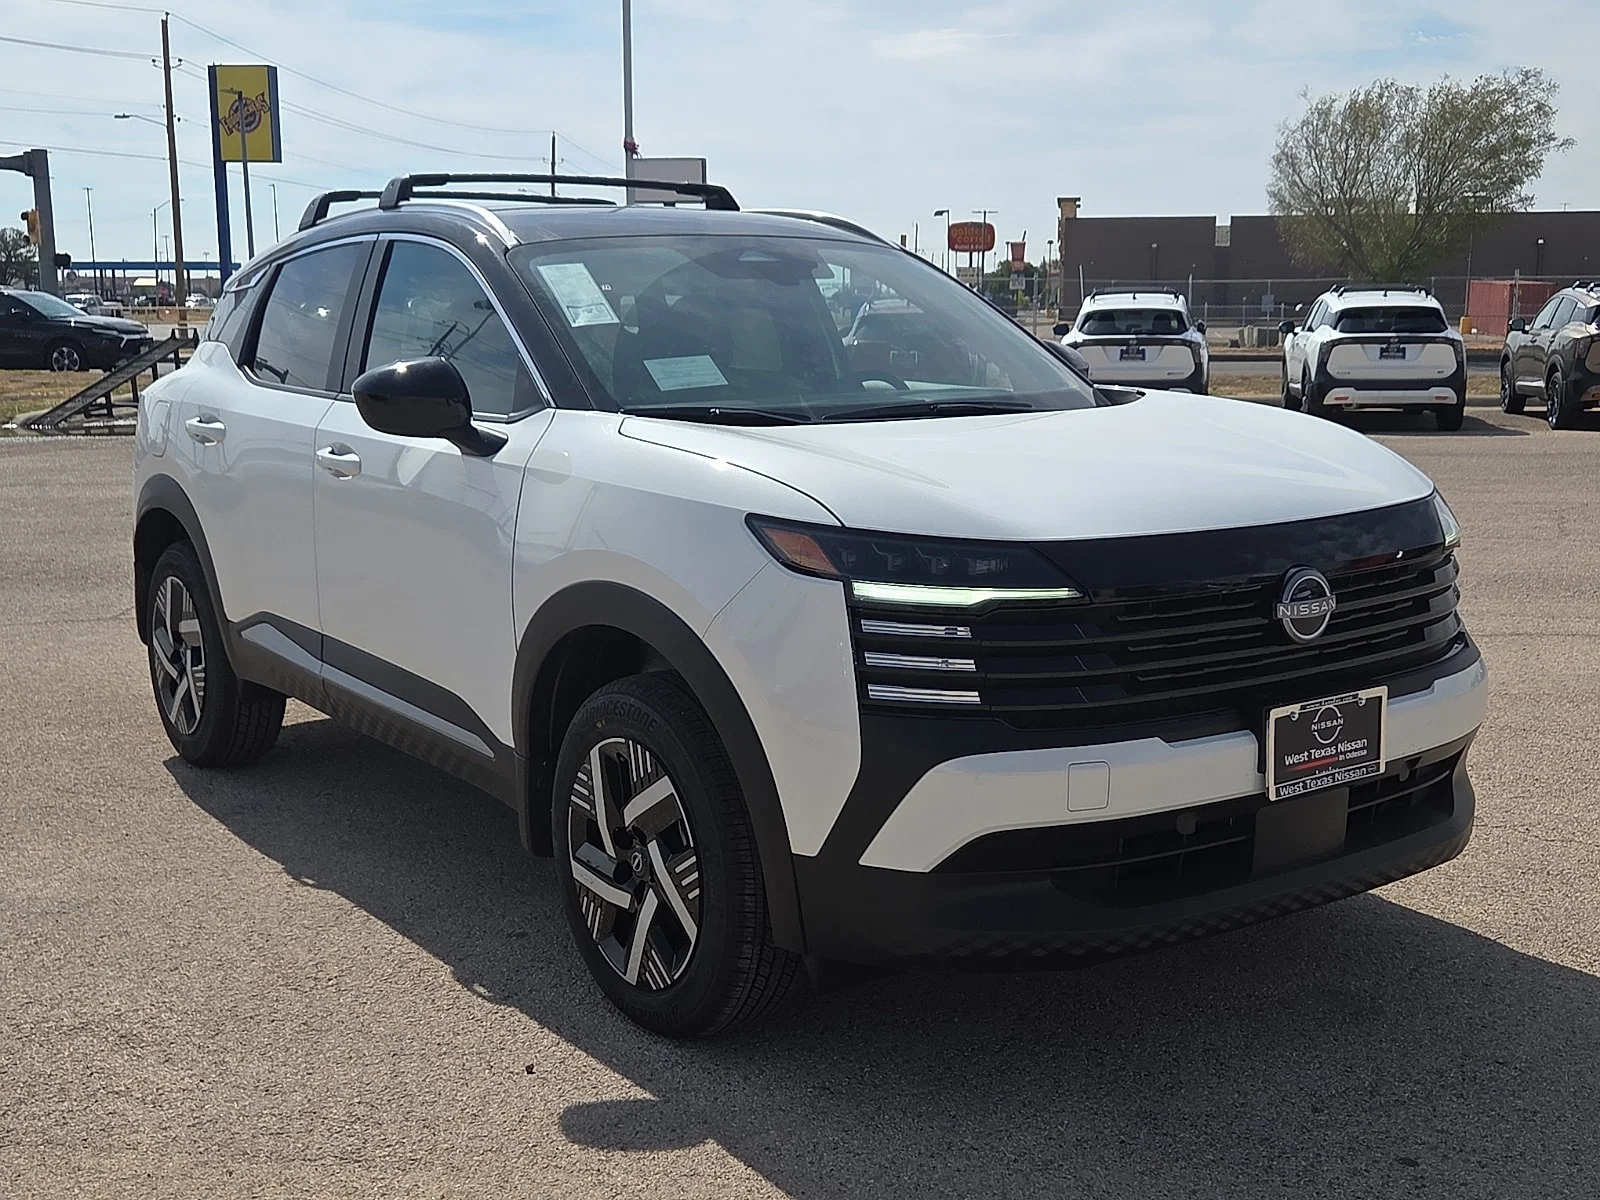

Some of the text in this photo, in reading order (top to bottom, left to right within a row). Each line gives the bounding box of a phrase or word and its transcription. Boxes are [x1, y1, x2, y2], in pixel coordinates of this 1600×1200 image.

[1279, 599, 1336, 616] NISSAN
[1311, 717, 1344, 731] NISSAN
[1284, 738, 1368, 766] West Texas Nissan
[1345, 749, 1368, 760] Odessa
[1279, 783, 1304, 797] West
[1305, 776, 1333, 790] Texas
[1334, 768, 1367, 781] Nissan
